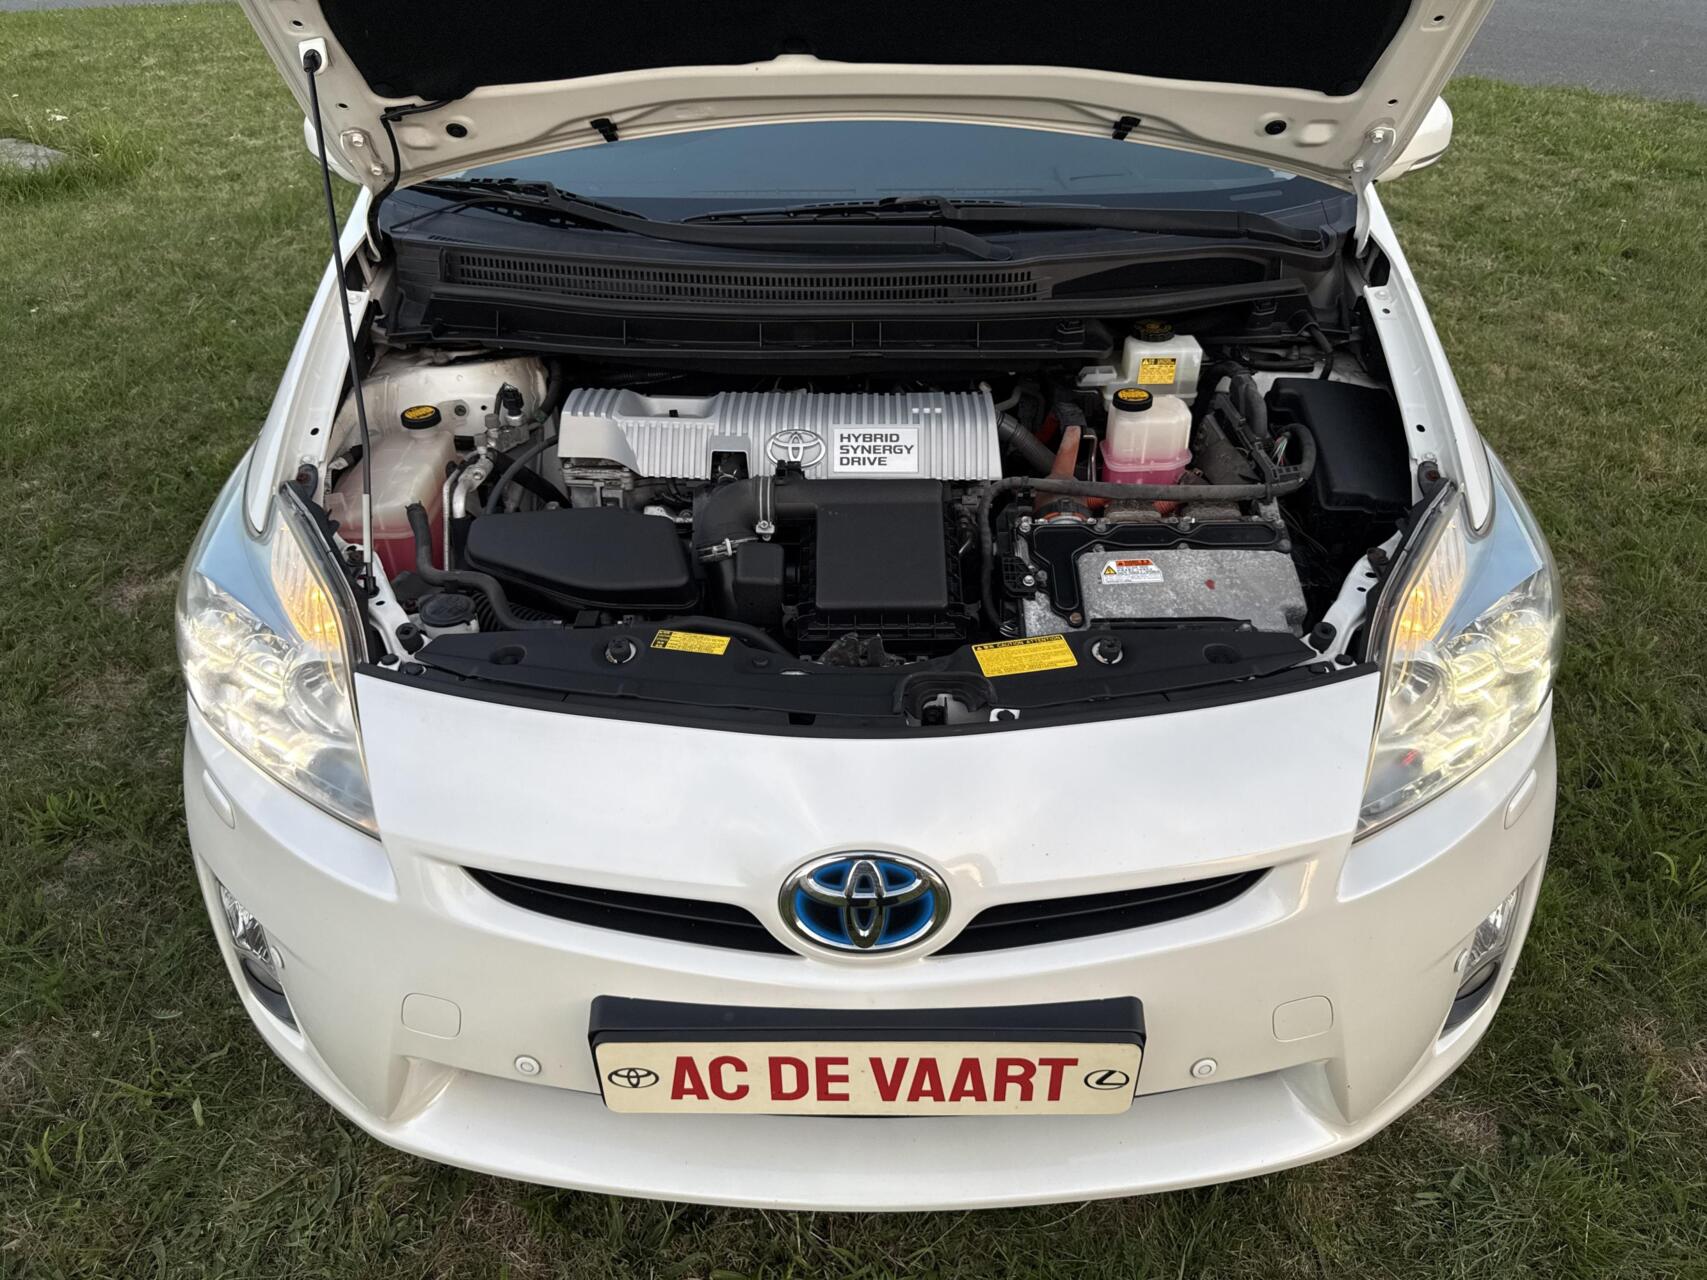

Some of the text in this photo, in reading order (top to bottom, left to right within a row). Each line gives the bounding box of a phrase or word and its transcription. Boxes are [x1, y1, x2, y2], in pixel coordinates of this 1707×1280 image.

[839, 433, 900, 443] HYBRID
[839, 444, 914, 455] SYNERGY
[839, 456, 887, 466] DRIVE
[670, 1055, 1079, 1102] AC DE VAART
